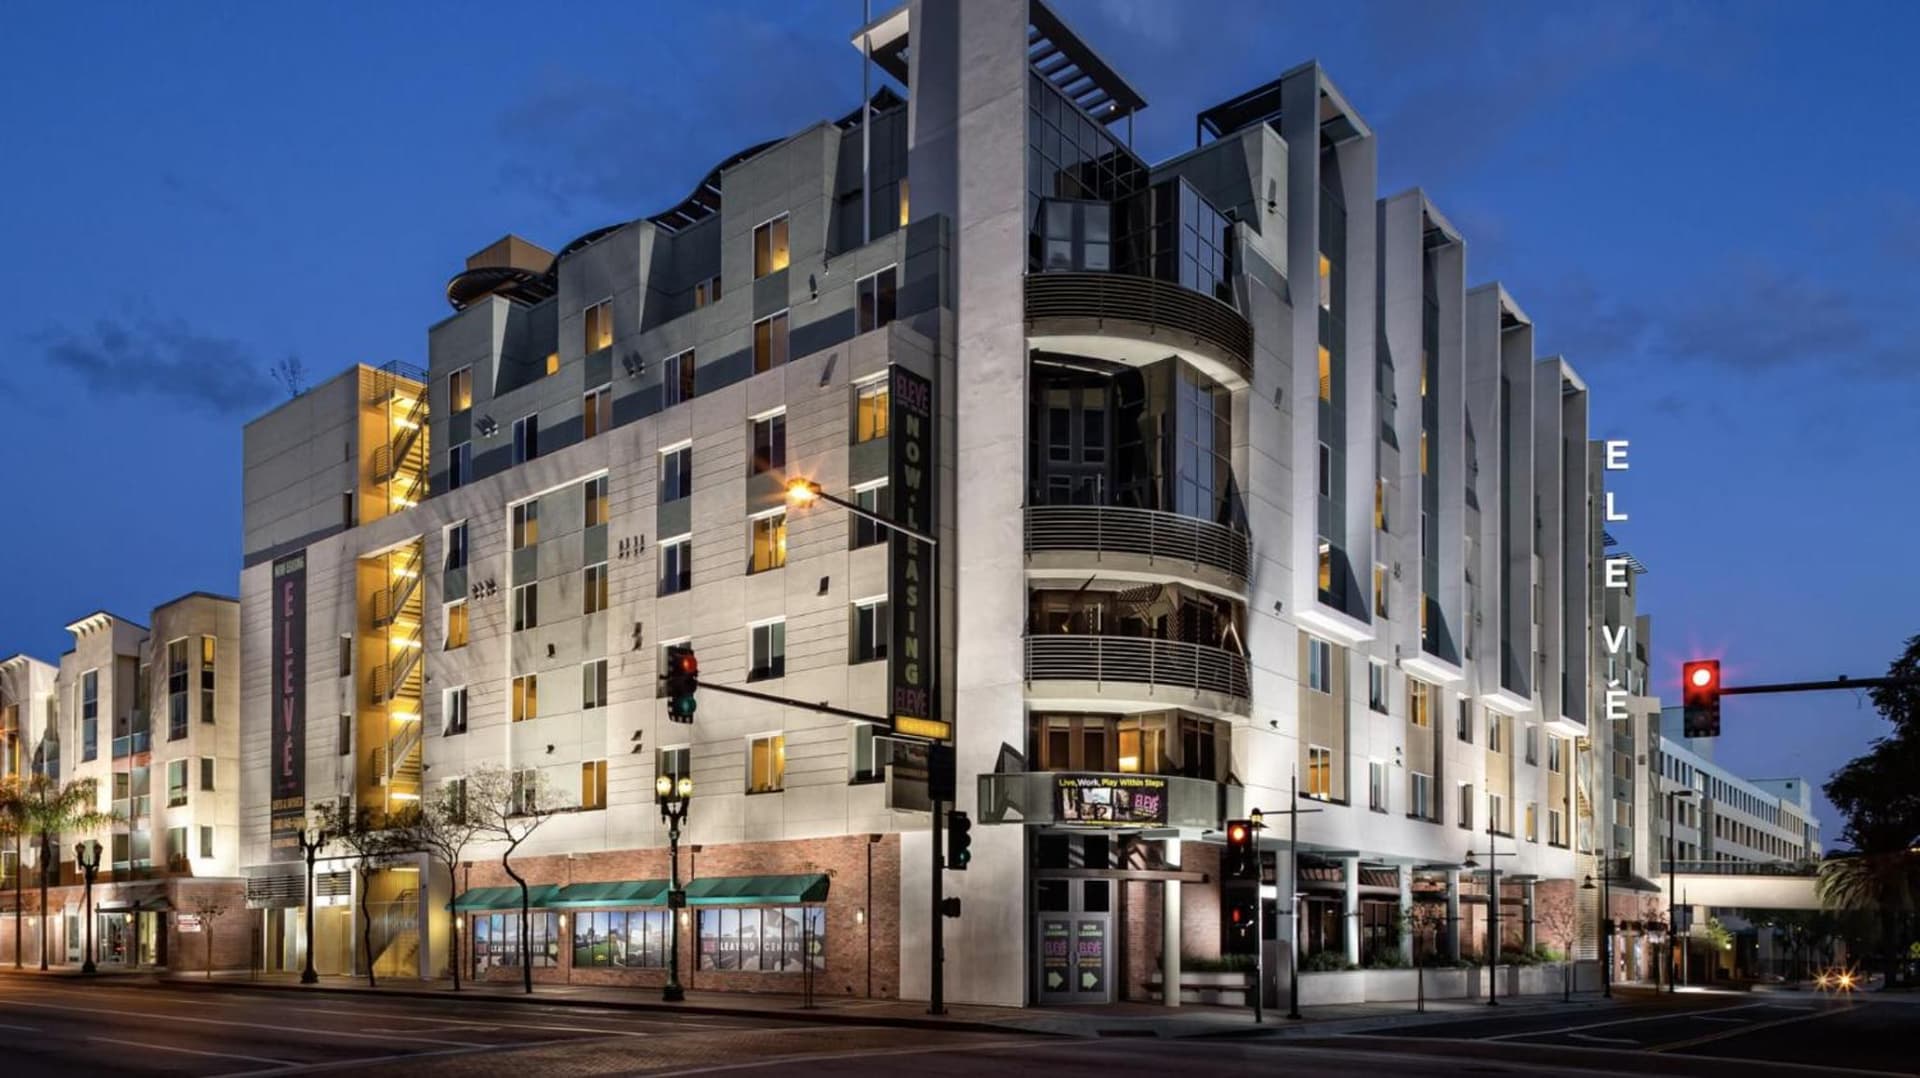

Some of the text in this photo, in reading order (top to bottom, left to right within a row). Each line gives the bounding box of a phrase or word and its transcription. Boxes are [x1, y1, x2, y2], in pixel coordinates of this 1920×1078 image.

[904, 414, 921, 490] NOW
[905, 508, 920, 685] LEASING
[1602, 440, 1630, 720] ELEVÉ
[284, 581, 294, 777] ELEVÉ
[1059, 779, 1077, 787] Live,
[1102, 779, 1117, 788] Play
[1119, 779, 1143, 787] Within
[720, 941, 755, 951] LEASNG
